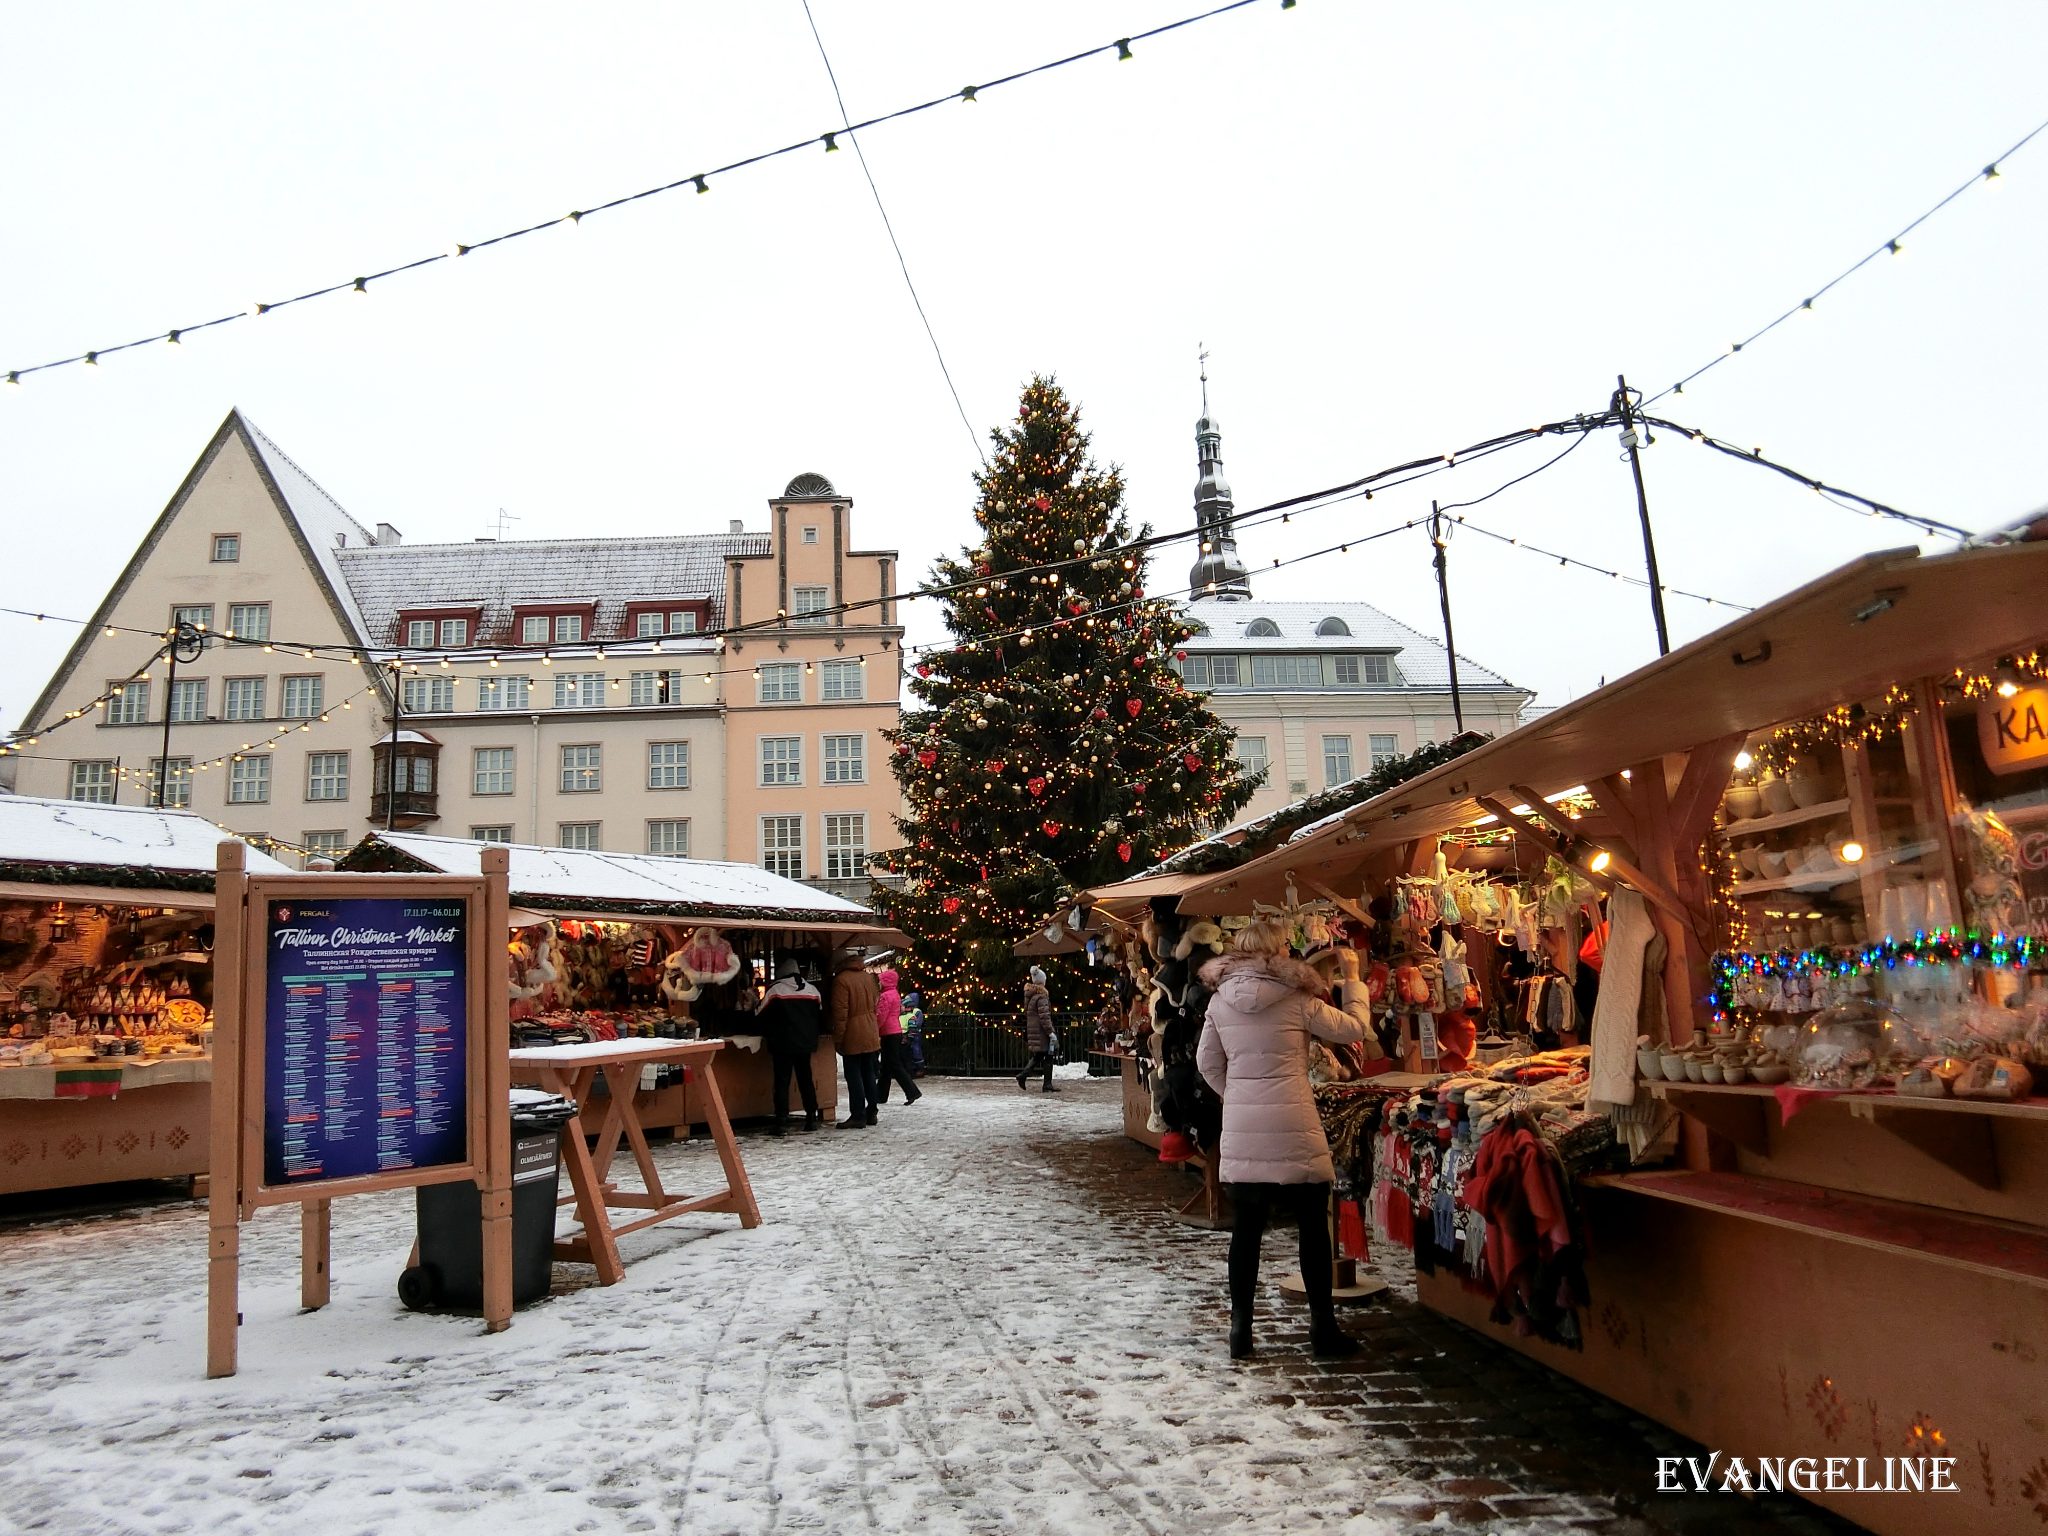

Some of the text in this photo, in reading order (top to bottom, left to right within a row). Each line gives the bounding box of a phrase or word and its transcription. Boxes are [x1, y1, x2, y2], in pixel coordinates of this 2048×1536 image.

[1992, 703, 2048, 748] KA
[274, 925, 460, 950] Tallinn Christmas Market
